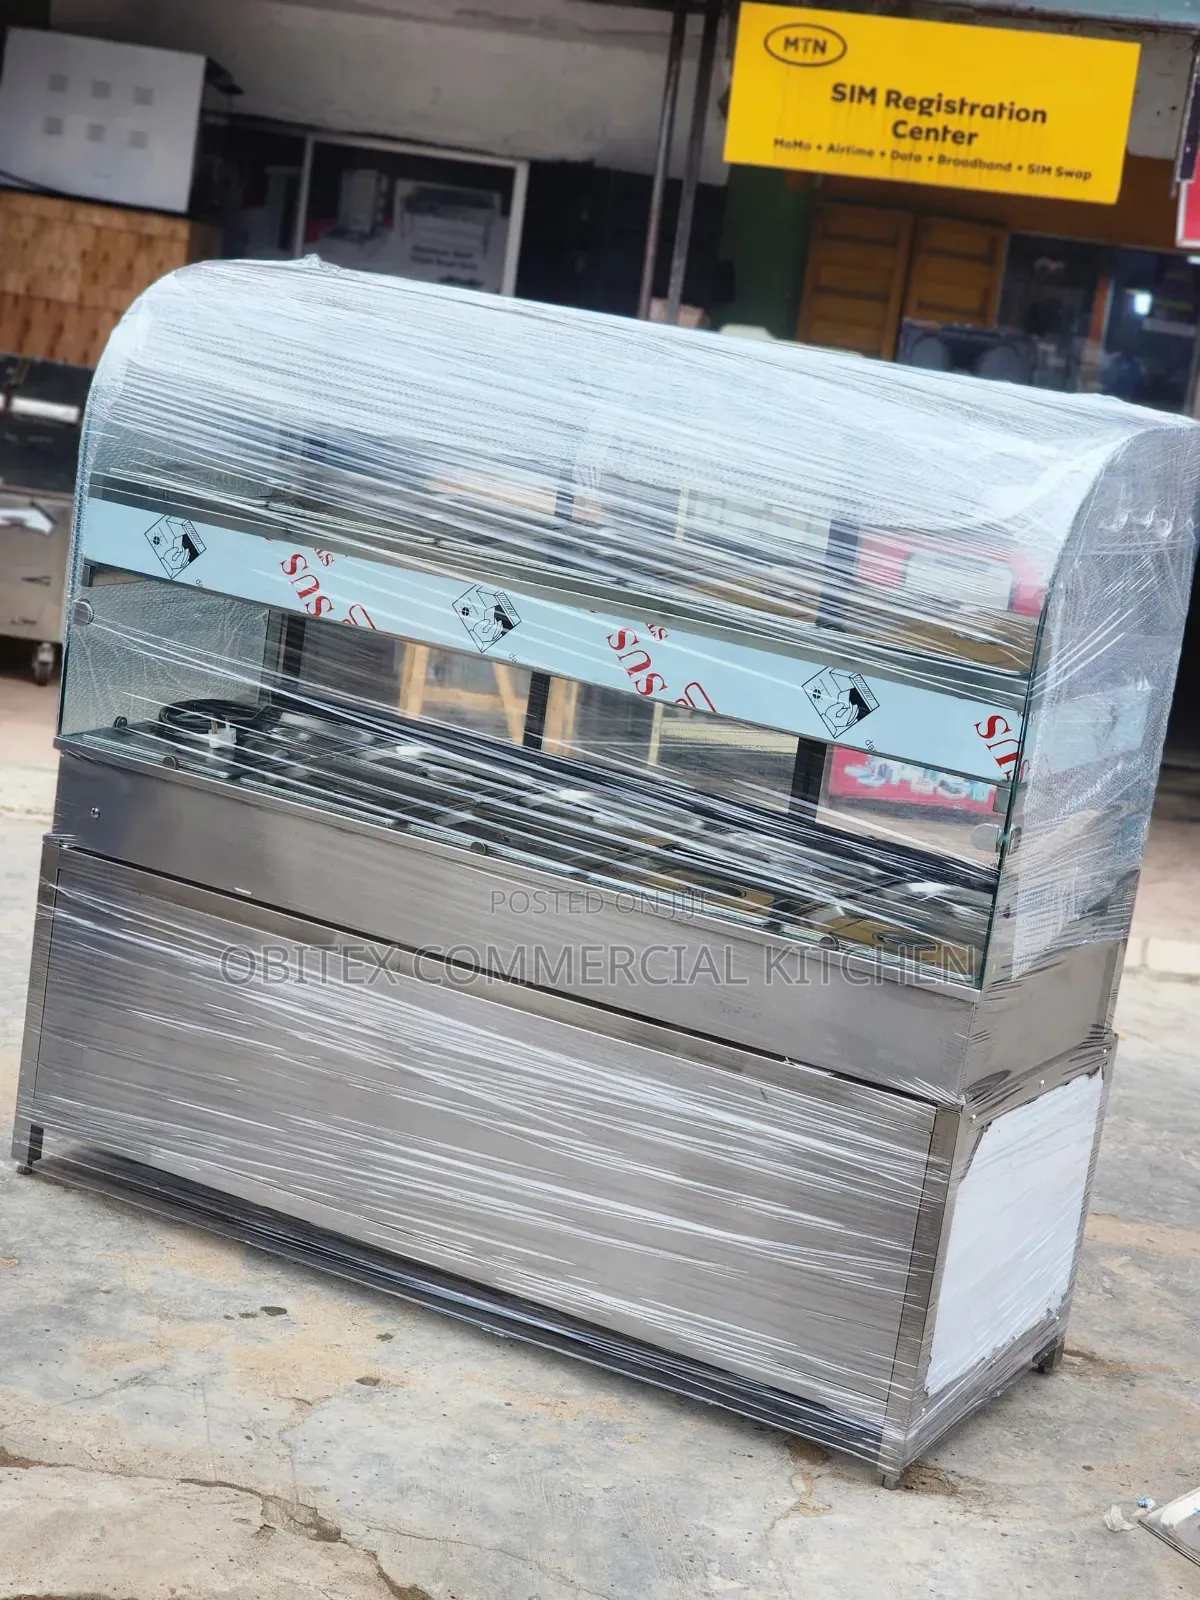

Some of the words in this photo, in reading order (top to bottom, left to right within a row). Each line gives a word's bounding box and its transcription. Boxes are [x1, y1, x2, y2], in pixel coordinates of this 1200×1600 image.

[783, 36, 828, 55] MTN
[831, 82, 878, 106] SIM
[885, 88, 1048, 124] Registration
[891, 119, 979, 146] Center
[773, 137, 812, 151] MoMo
[827, 143, 875, 158] Airtime
[891, 149, 922, 163] Data
[938, 154, 1012, 173] Broadband
[1027, 163, 1052, 176] SIM
[1055, 166, 1092, 182] Swap
[279, 553, 334, 617] SUS
[605, 627, 668, 696] SUS
